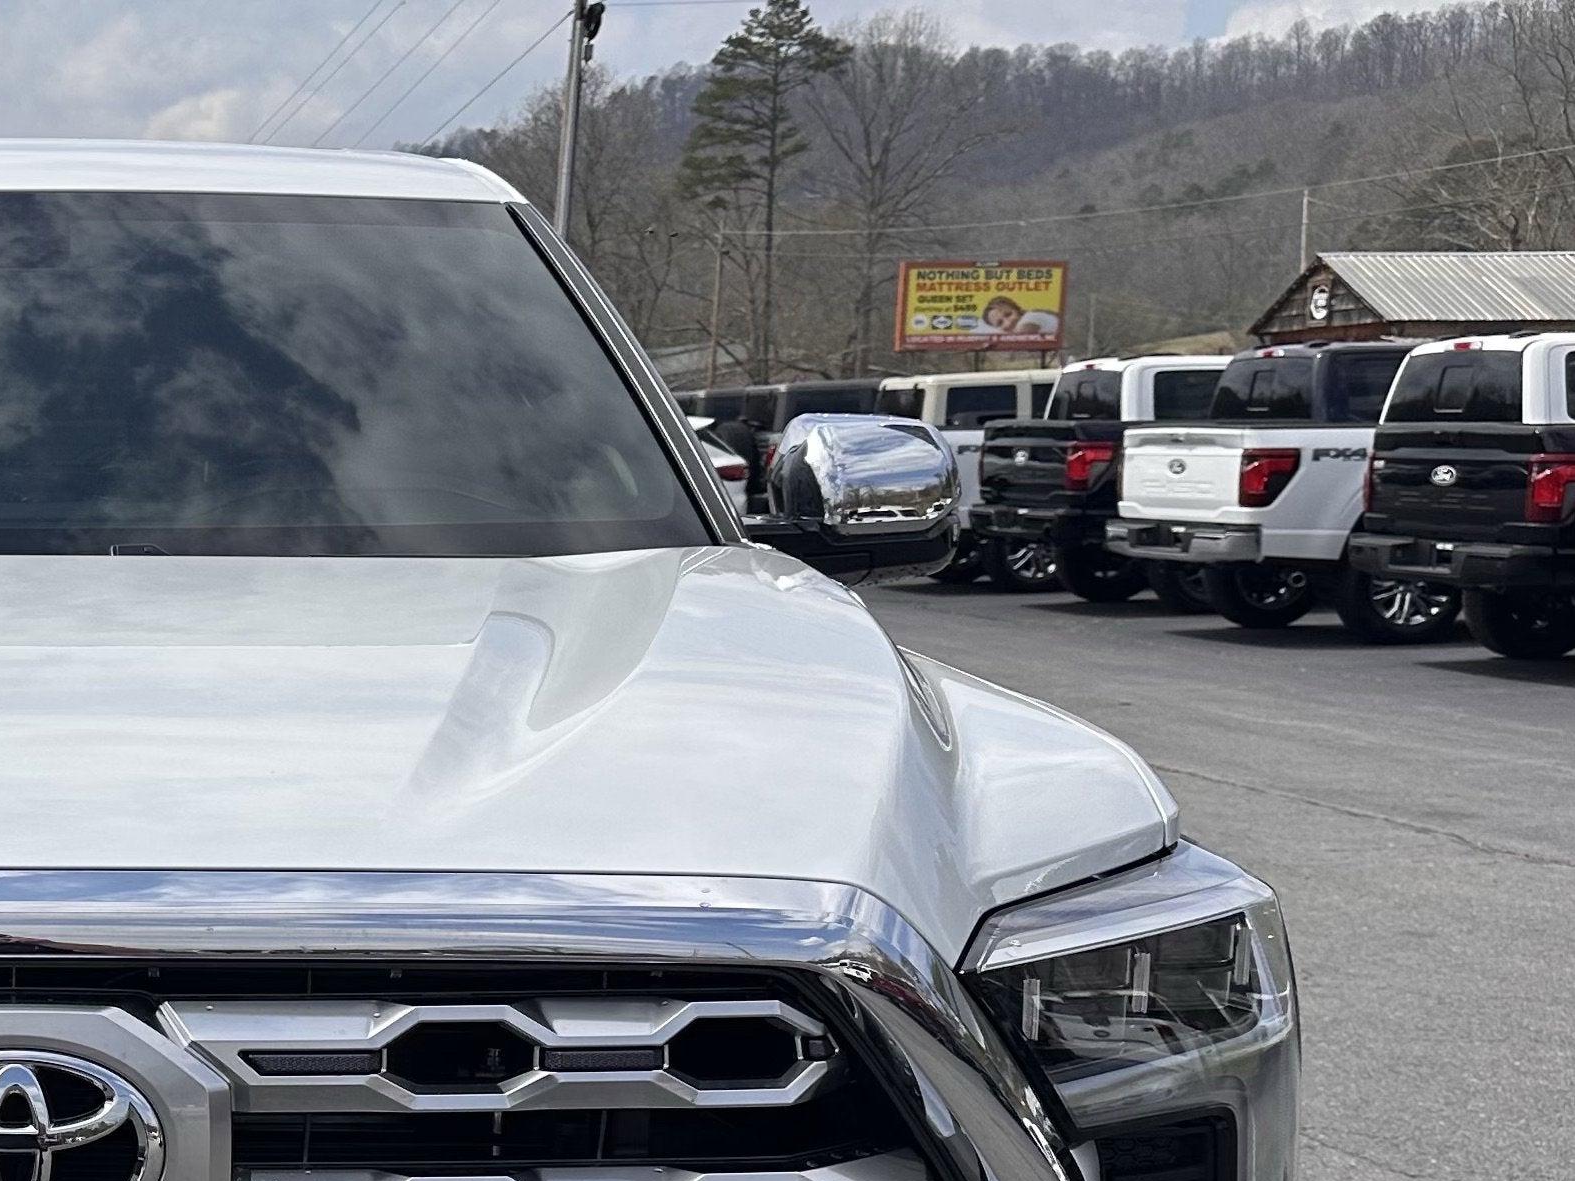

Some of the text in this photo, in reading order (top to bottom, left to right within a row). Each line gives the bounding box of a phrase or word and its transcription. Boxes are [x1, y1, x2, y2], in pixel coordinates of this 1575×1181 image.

[917, 269, 1053, 281] NOTHING BUT BEDS
[916, 281, 1052, 293] MATTRESS OUTLET
[918, 294, 974, 304] QUEEN SET
[1312, 447, 1367, 462] FX4
